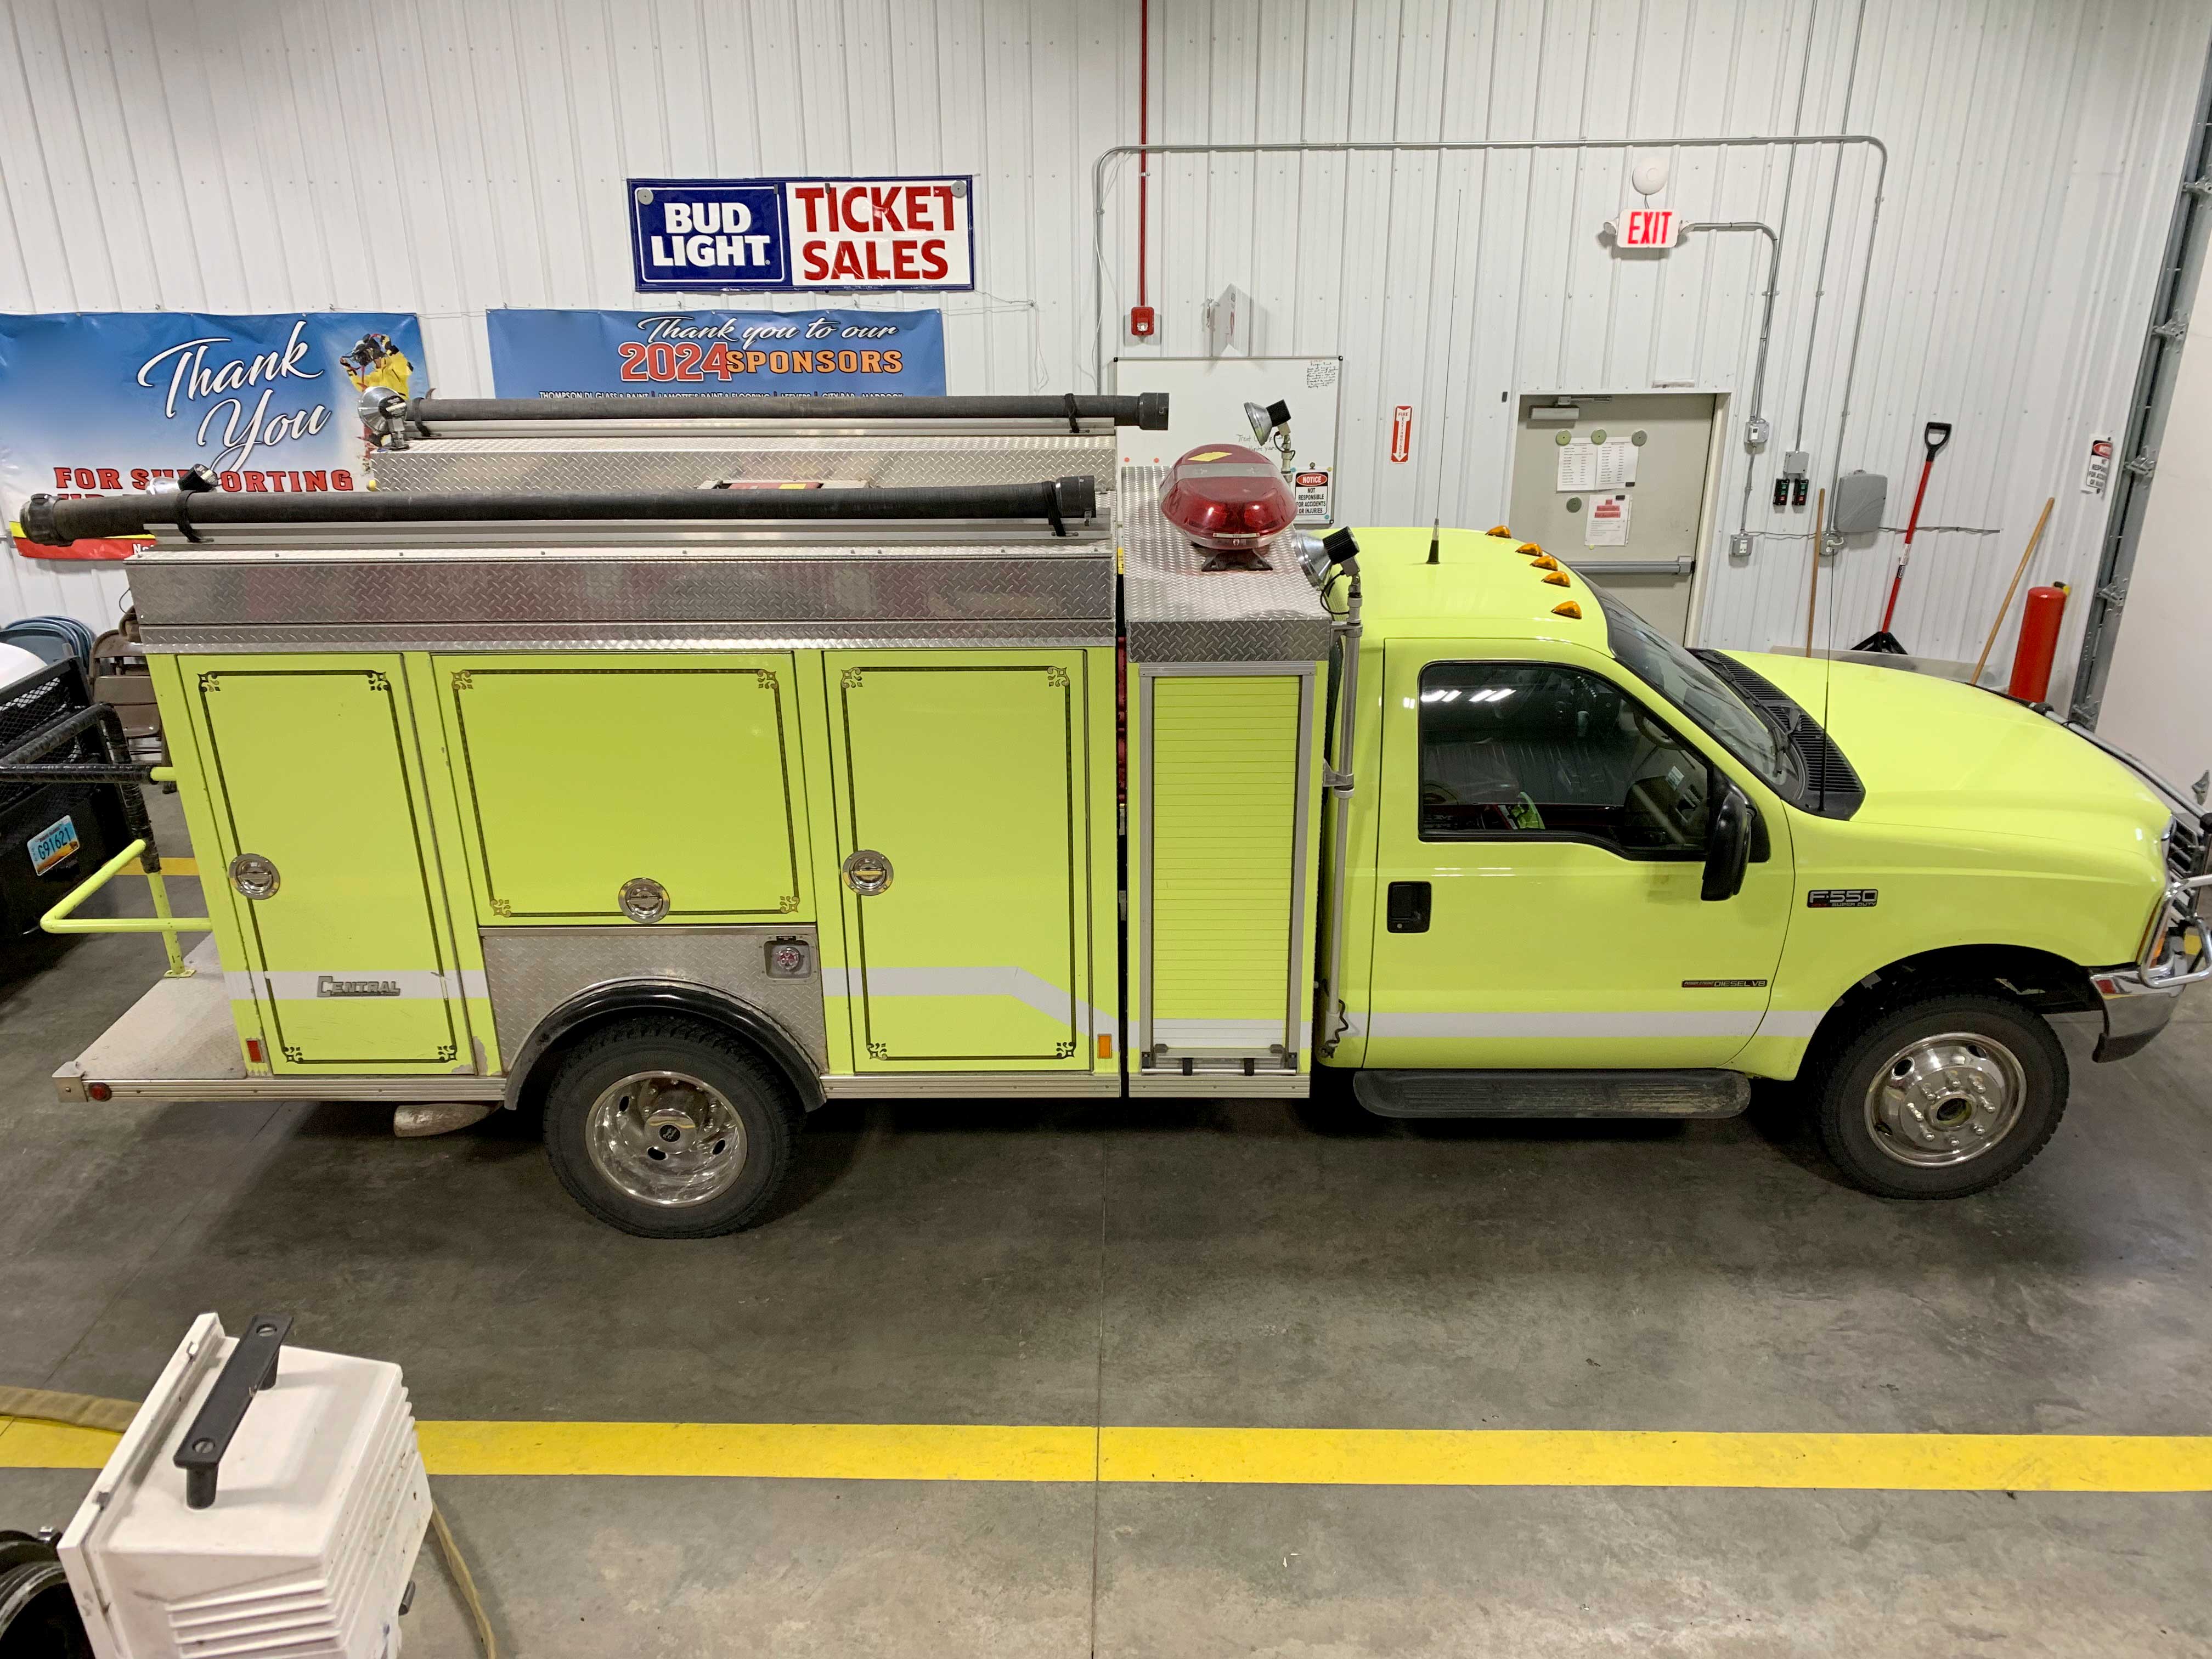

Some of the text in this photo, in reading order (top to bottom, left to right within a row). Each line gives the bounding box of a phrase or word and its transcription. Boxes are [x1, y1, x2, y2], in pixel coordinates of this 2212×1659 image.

[664, 202, 752, 234] BUD
[794, 185, 957, 233] TICKET
[1628, 211, 1673, 244] EXIT
[651, 235, 770, 267] LIGHT
[803, 239, 949, 281] SALES
[637, 315, 899, 351] Thank you to our
[137, 320, 325, 419] Thank
[618, 341, 903, 382] 2024 SPONSORS
[196, 388, 331, 473] You
[54, 467, 123, 489] FOR
[131, 469, 353, 492] SORTING
[37, 827, 71, 860] G91621
[317, 975, 400, 997] CENTRAL
